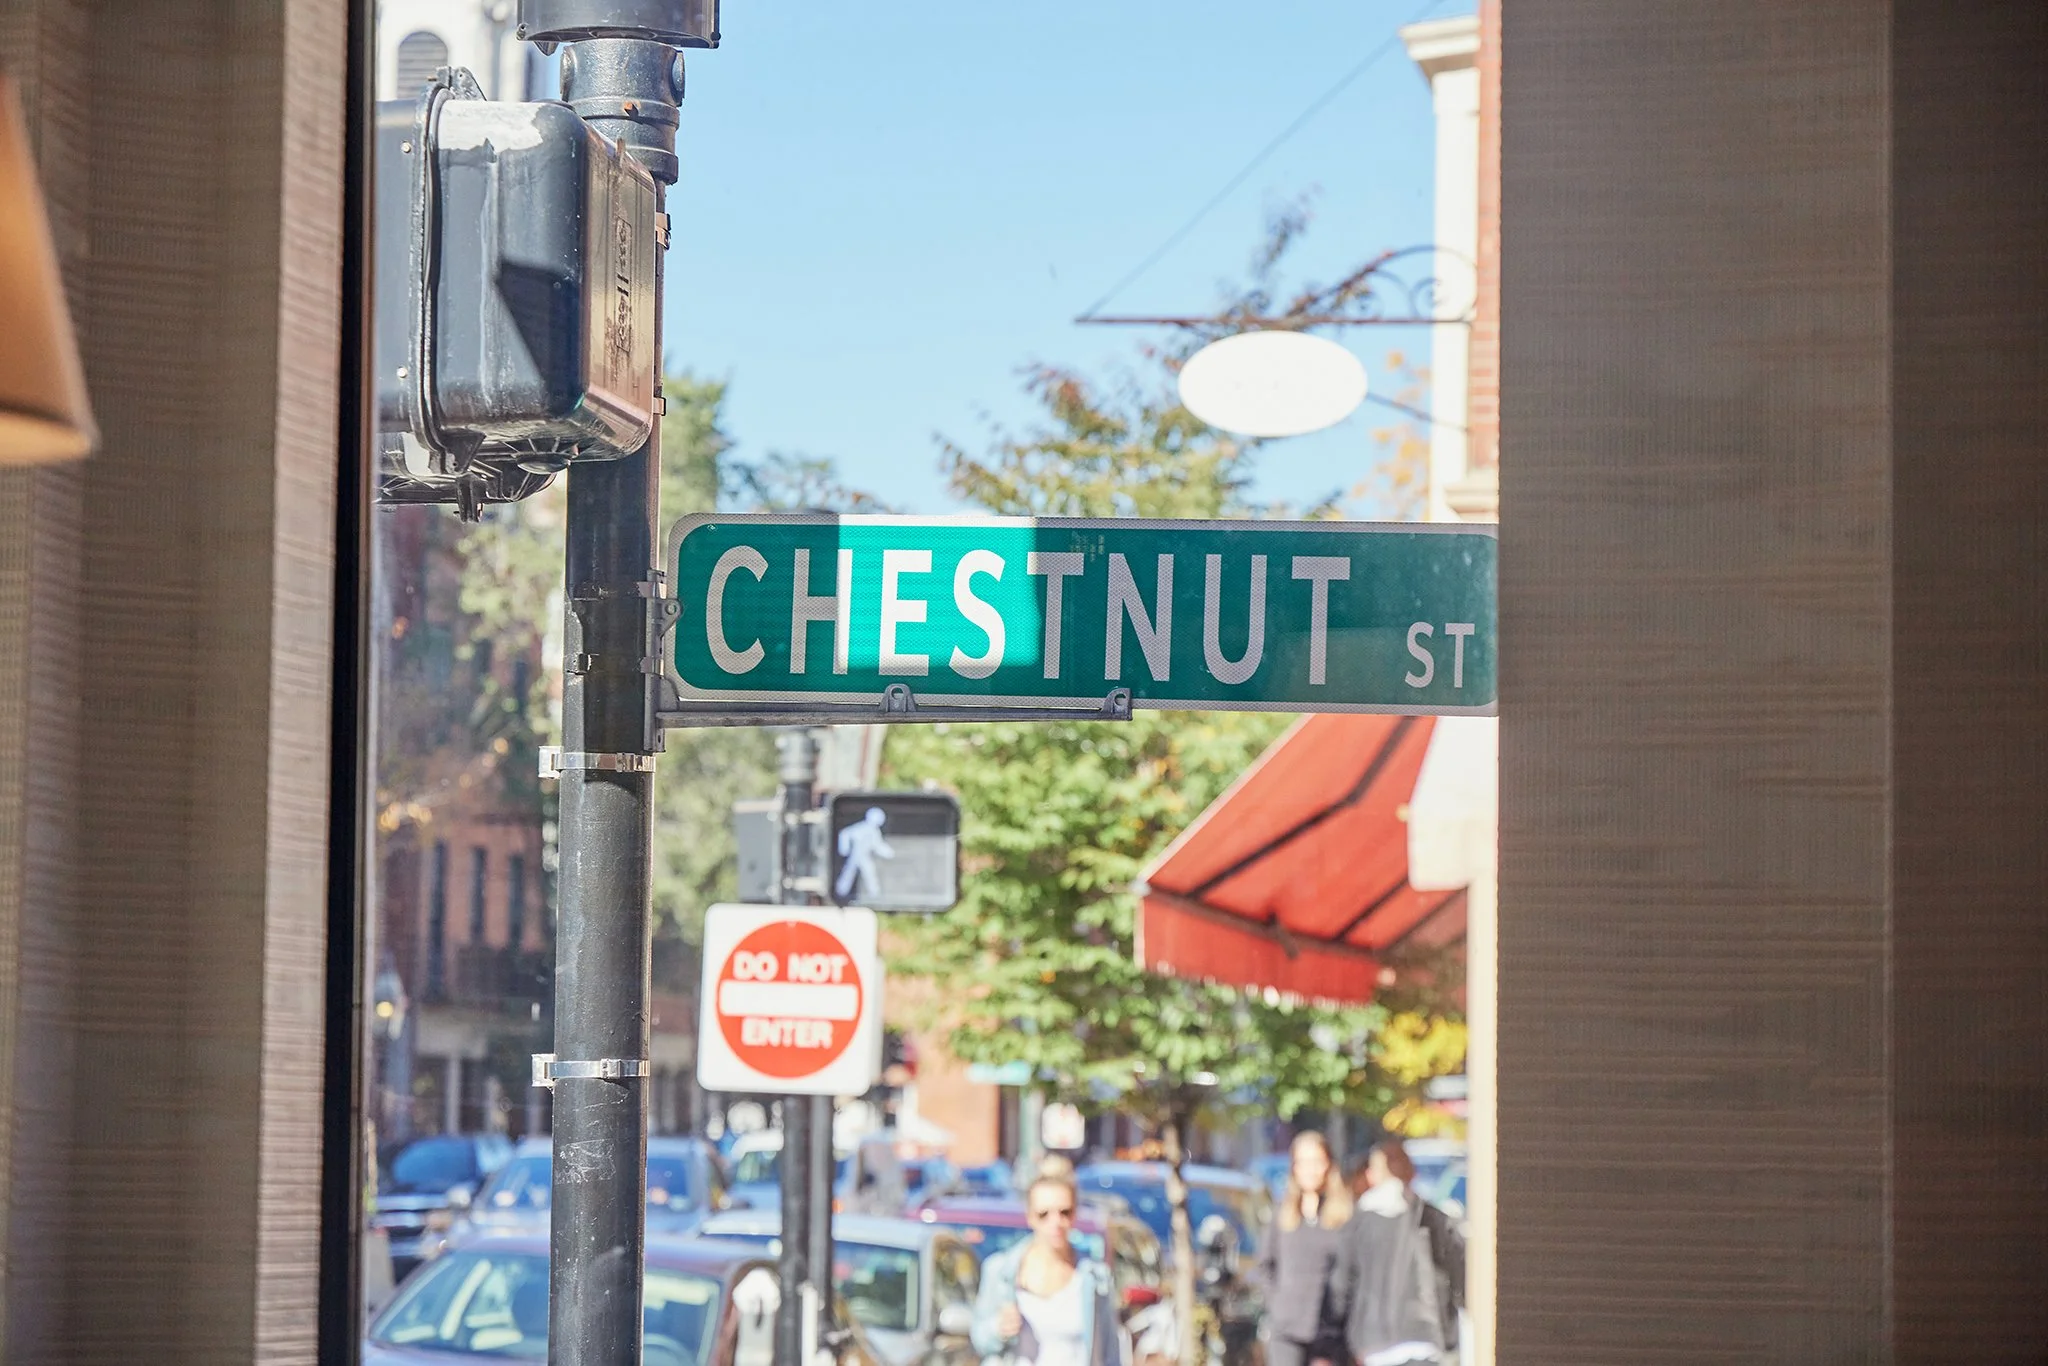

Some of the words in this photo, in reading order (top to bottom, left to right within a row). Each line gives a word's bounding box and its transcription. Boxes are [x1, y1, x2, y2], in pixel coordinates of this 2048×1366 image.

[705, 545, 1350, 686] CHESTNUT
[1405, 622, 1475, 688] ST
[734, 952, 778, 981] DO
[789, 954, 848, 983] NOT
[742, 1018, 833, 1049] ENTER
